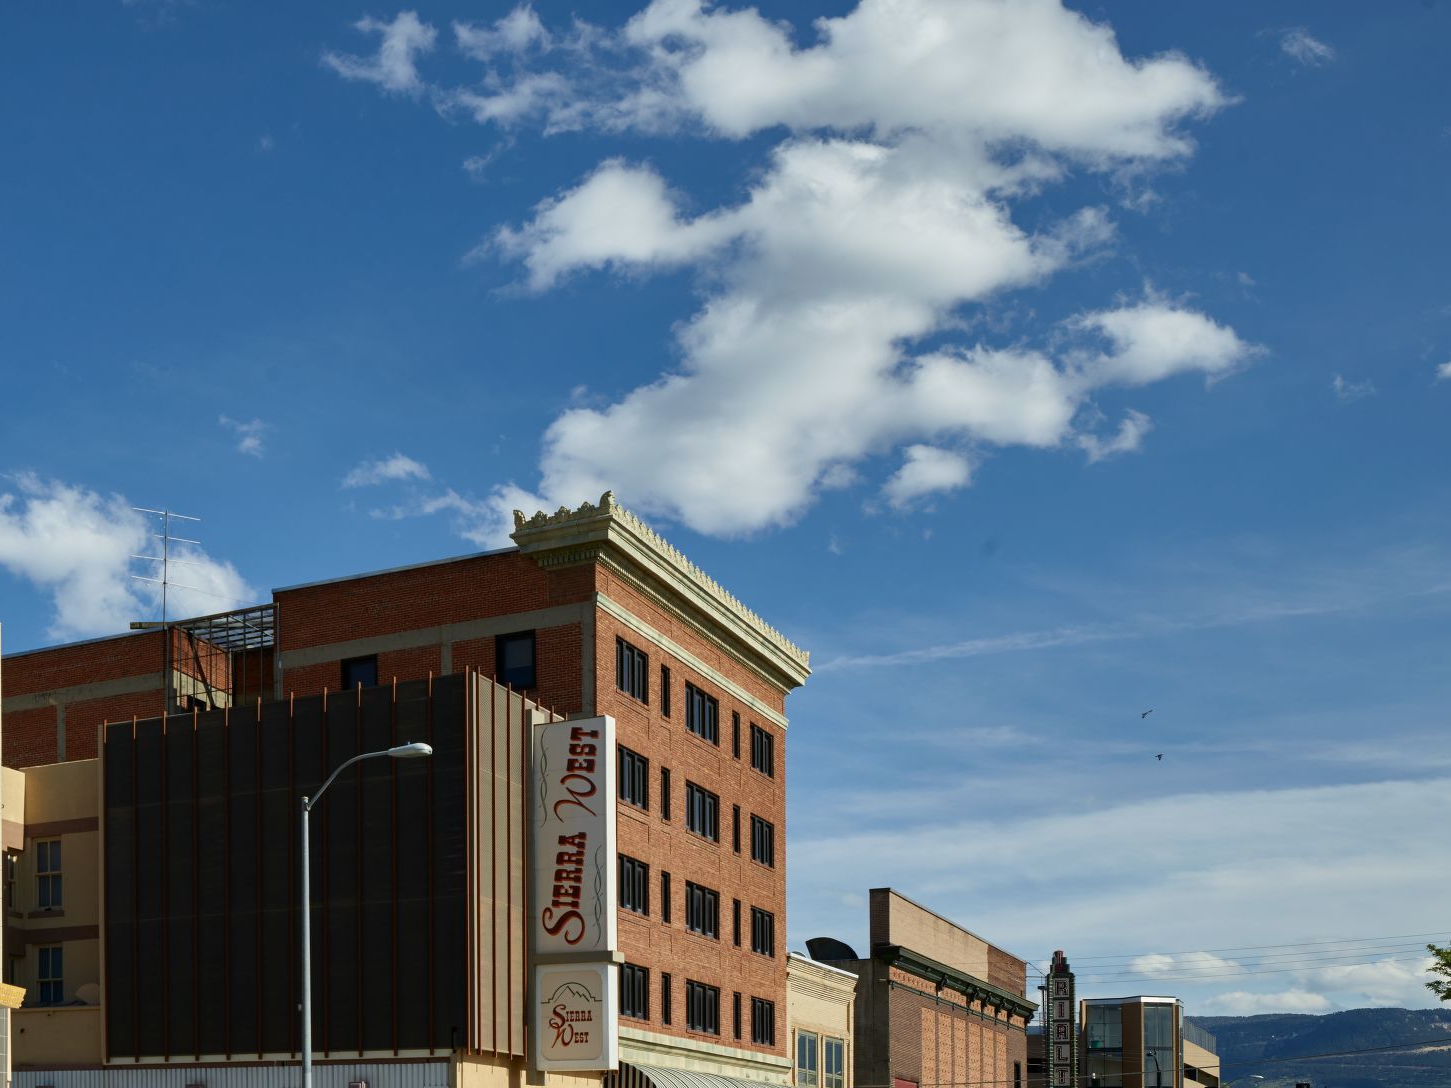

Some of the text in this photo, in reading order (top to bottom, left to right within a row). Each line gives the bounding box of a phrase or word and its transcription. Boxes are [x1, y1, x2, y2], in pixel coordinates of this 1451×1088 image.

[542, 727, 599, 945] SIERRA WEST
[549, 1003, 593, 1029] SIERRA
[551, 1023, 589, 1049] WEST
